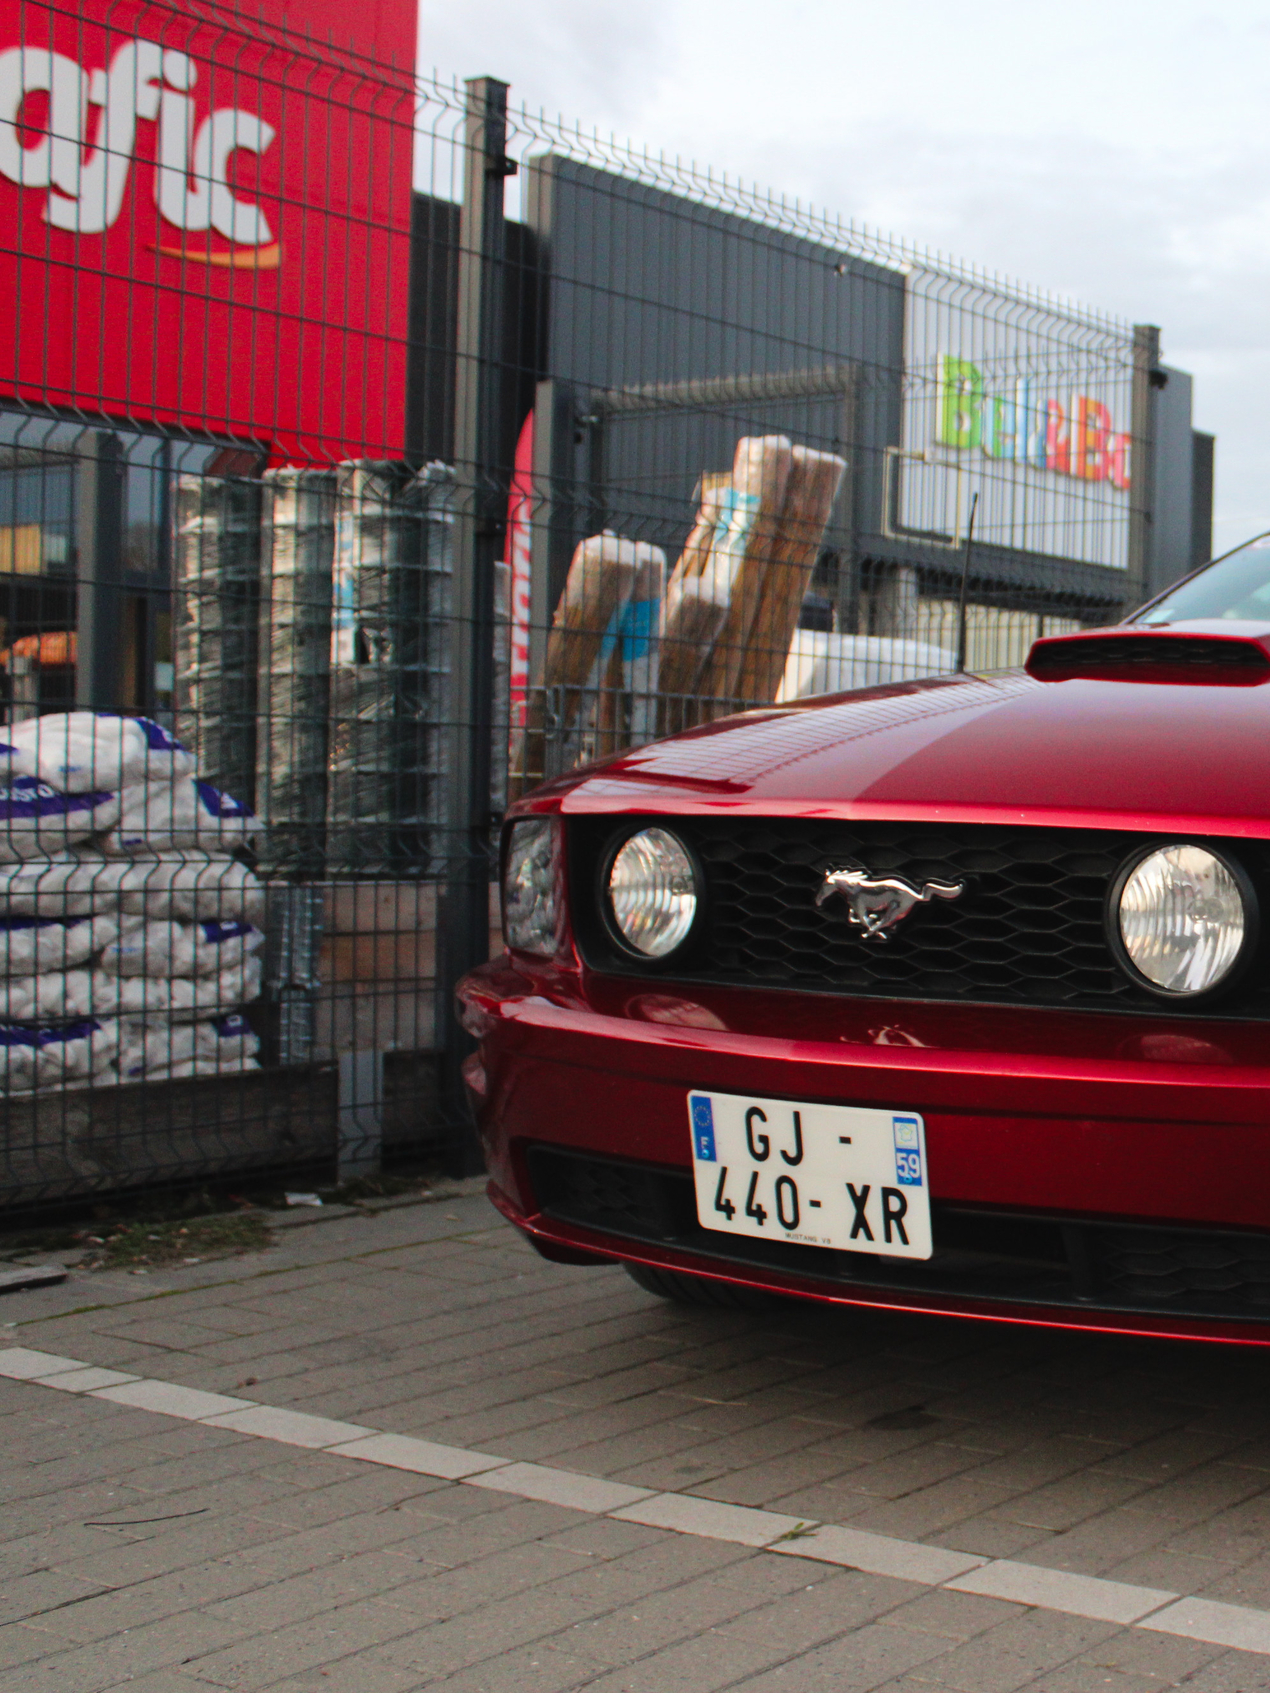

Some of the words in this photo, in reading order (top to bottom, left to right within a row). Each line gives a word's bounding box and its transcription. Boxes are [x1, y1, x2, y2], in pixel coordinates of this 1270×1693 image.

[745, 1106, 804, 1167] GJ
[896, 1152, 921, 1179] 59
[845, 1182, 910, 1246] XR
